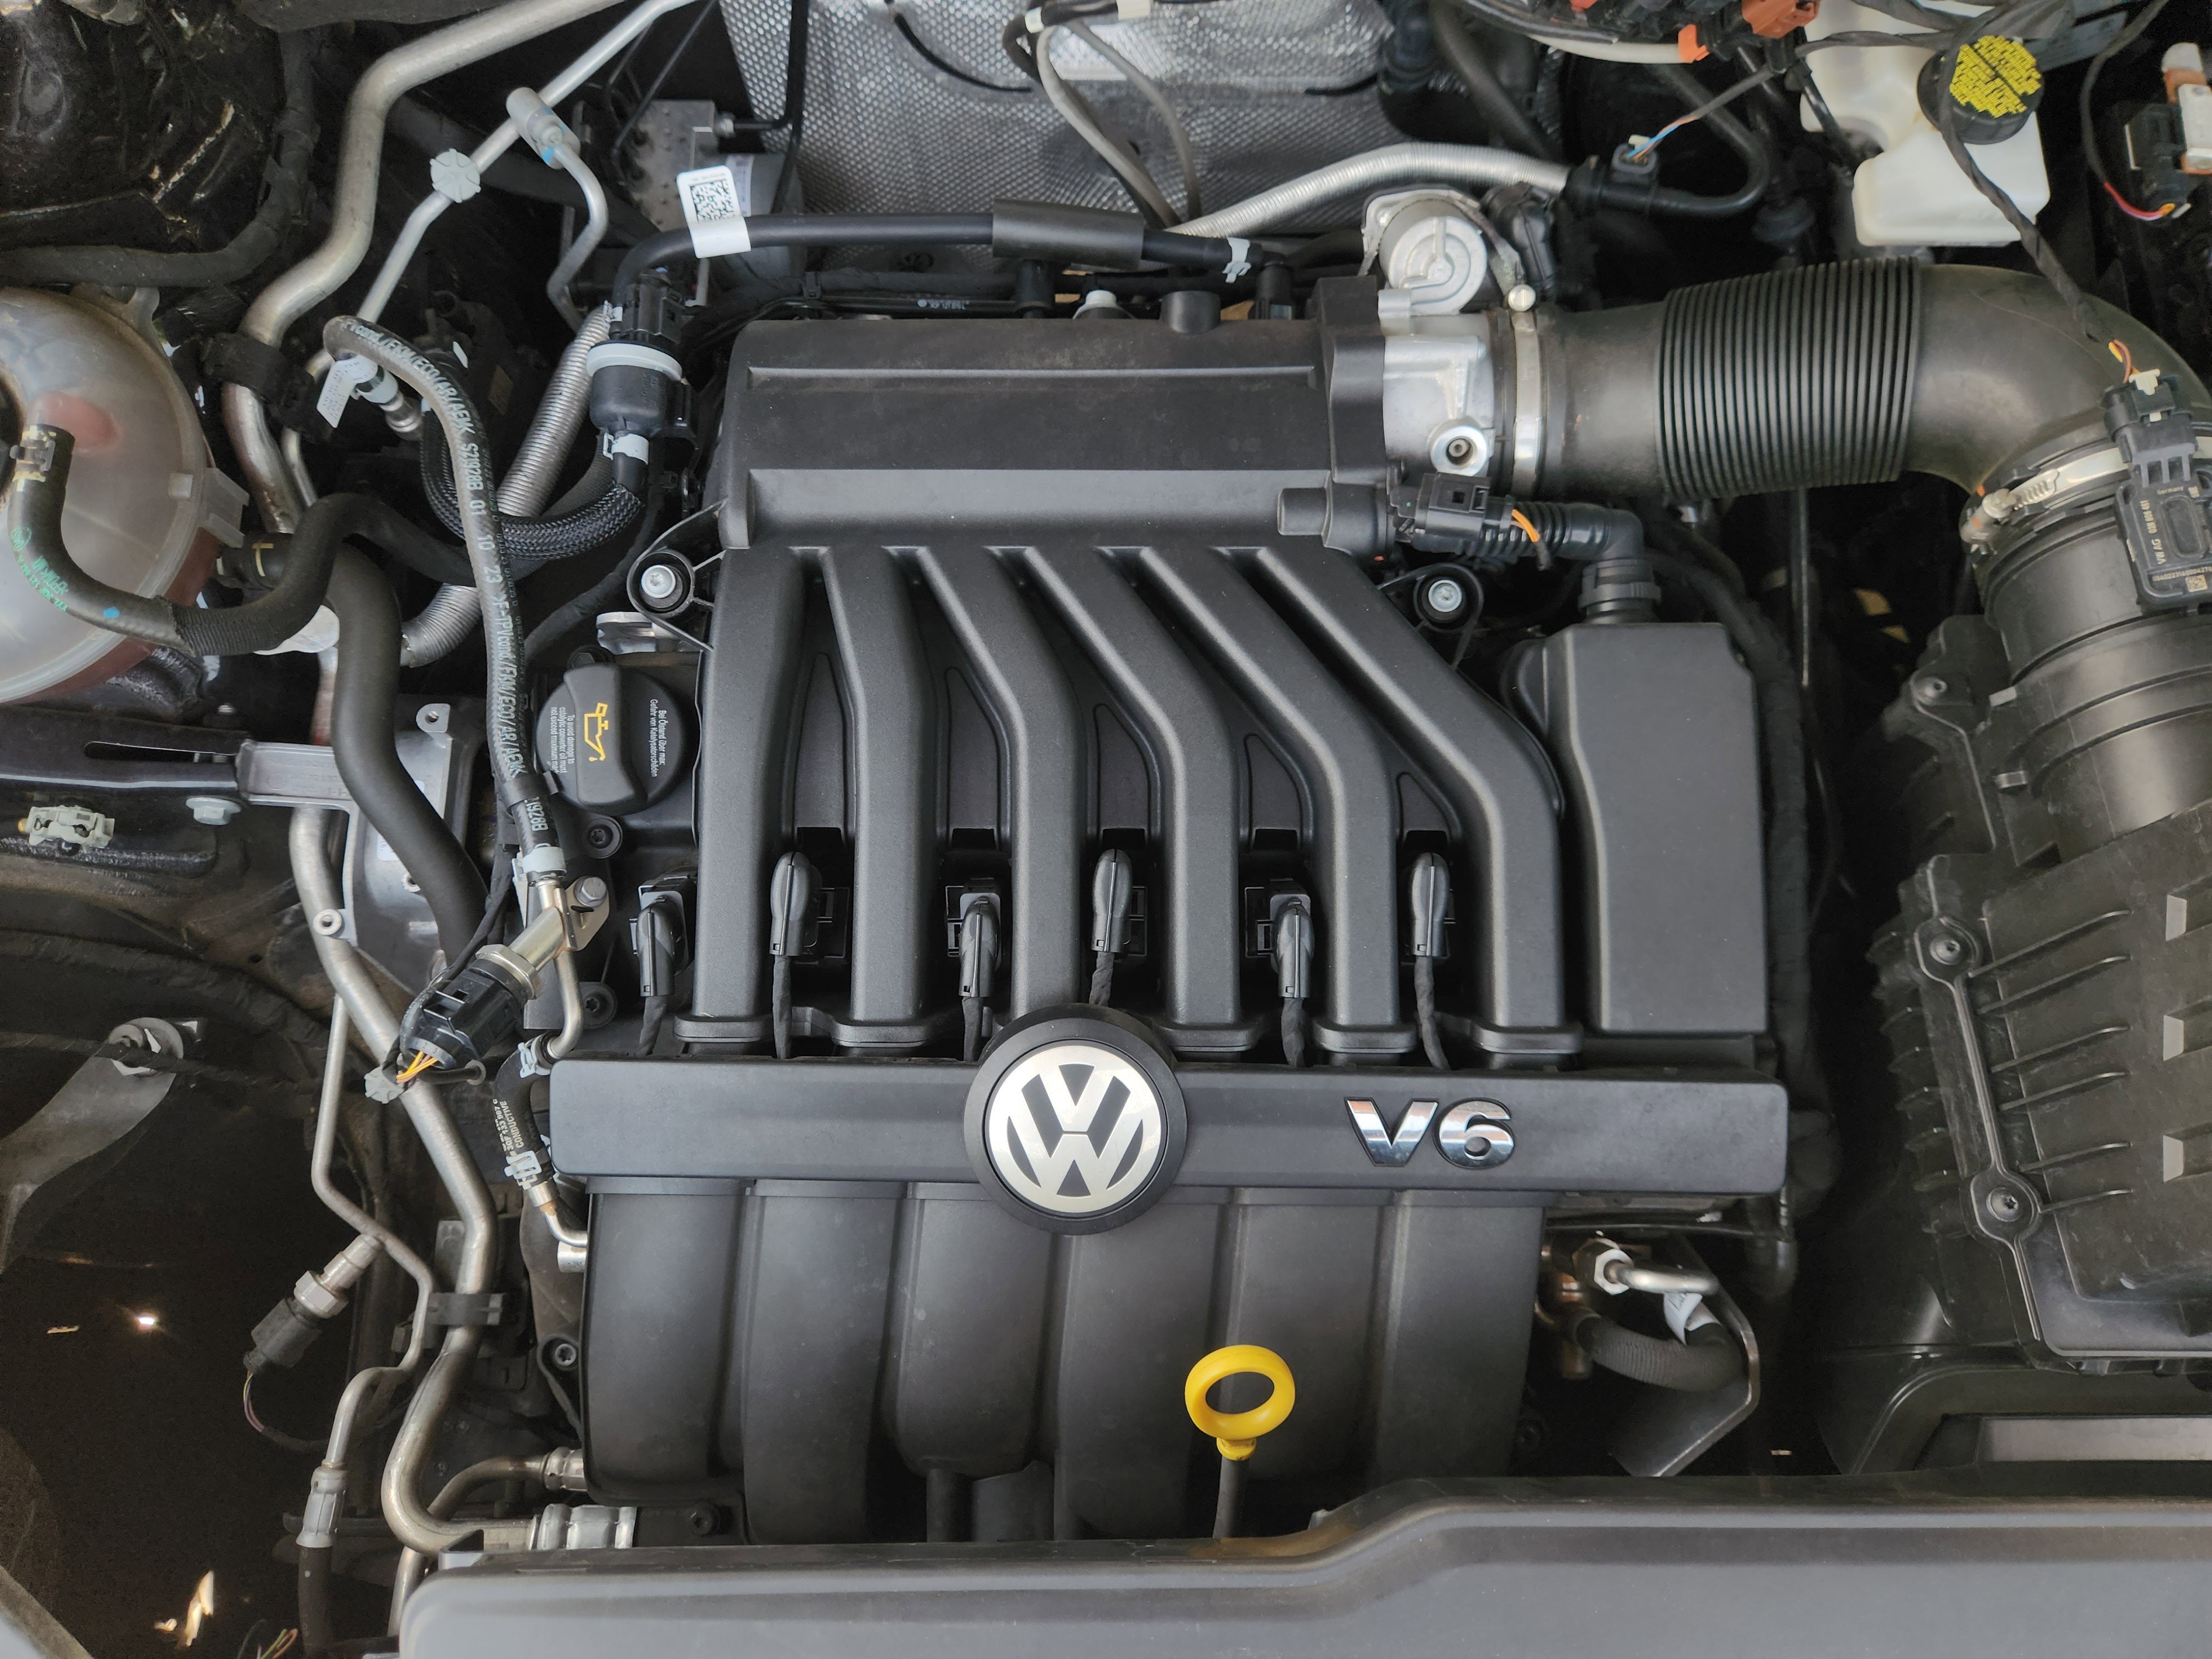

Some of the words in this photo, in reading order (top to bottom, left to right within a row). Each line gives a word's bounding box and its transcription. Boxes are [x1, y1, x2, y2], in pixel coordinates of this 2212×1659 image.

[469, 499, 487, 515] 01
[477, 534, 495, 550] 10
[2151, 539, 2163, 550] AG
[484, 565, 503, 583] 23
[650, 699, 658, 716] Gefahr
[658, 709, 666, 718] Bei
[558, 707, 567, 727] catalytic
[658, 720, 668, 739] Ölstand
[566, 737, 575, 758] damage
[648, 728, 658, 777] Katalysatorschäden
[659, 740, 667, 752] über
[499, 1100, 524, 1148] CONDUCTIVE
[499, 1120, 508, 1135] 133
[989, 1044, 1162, 1213] VW
[1344, 1097, 1515, 1168] V6
